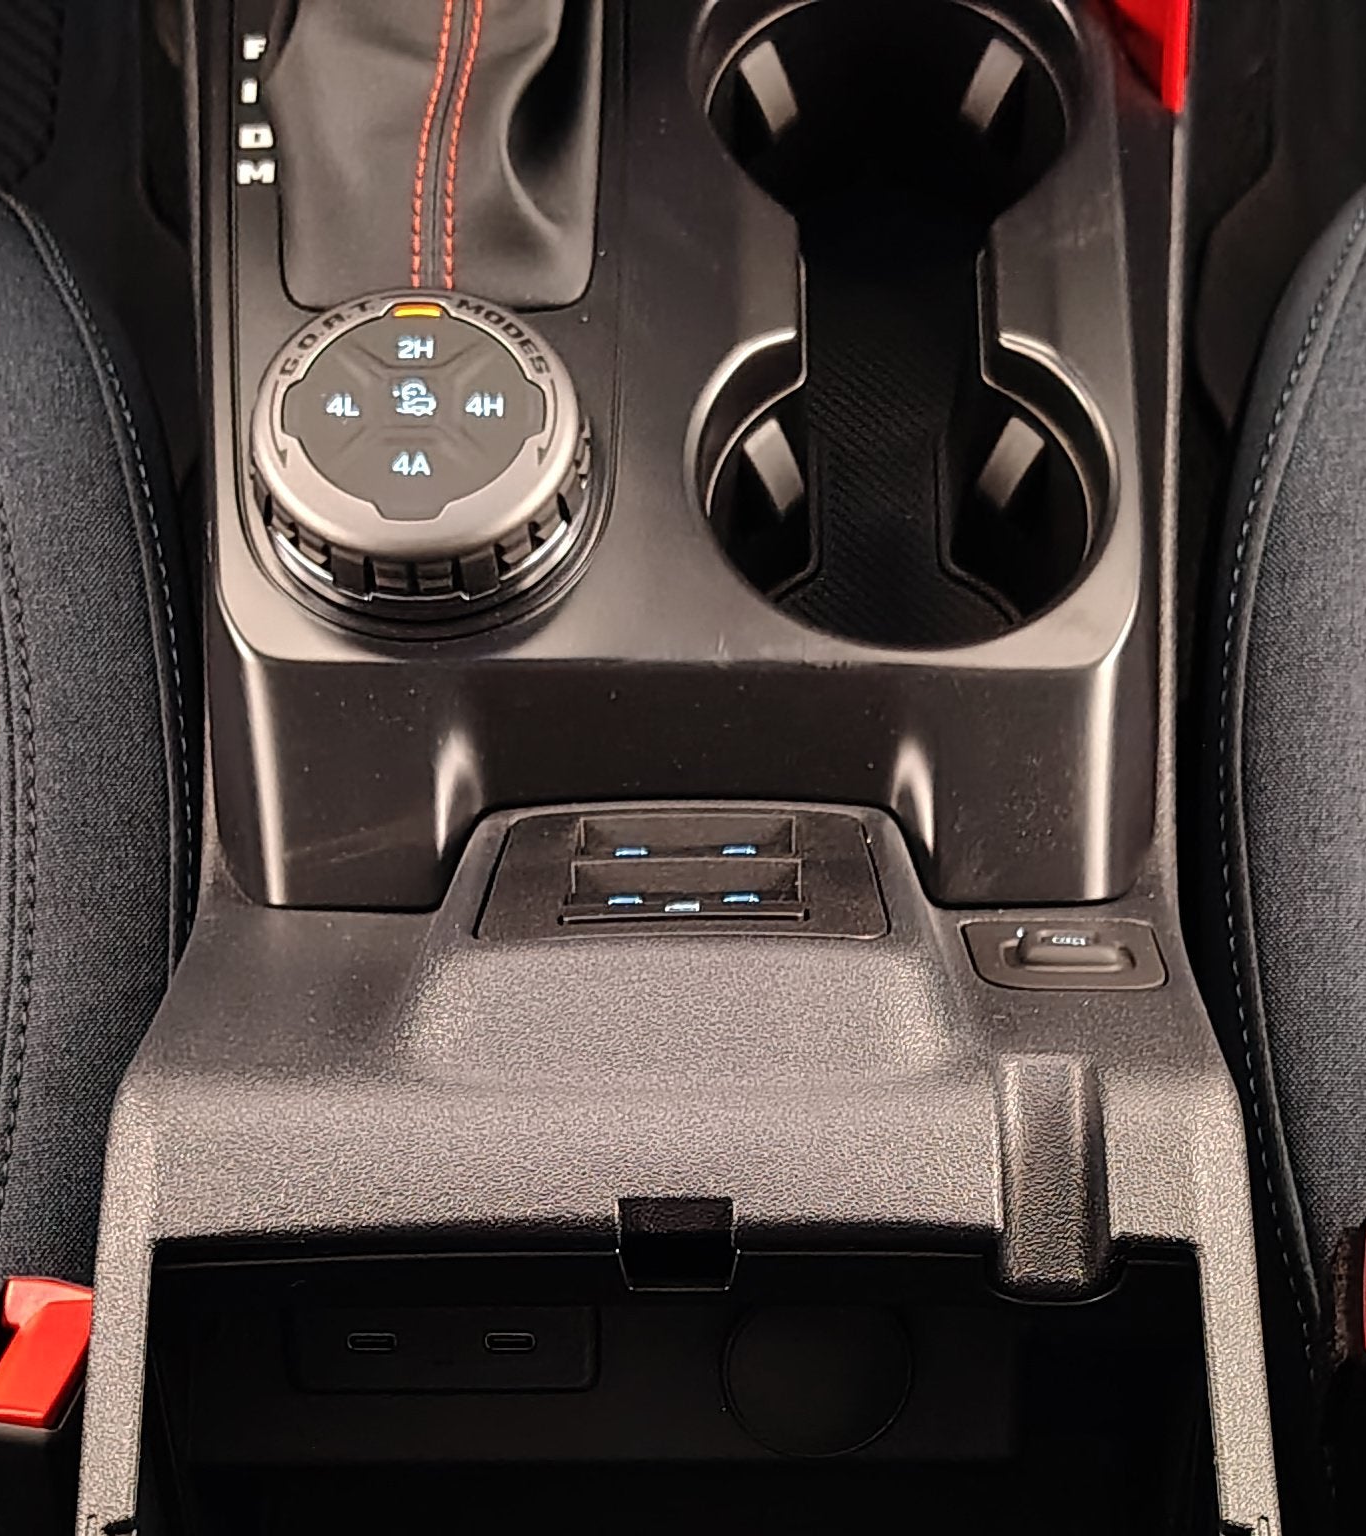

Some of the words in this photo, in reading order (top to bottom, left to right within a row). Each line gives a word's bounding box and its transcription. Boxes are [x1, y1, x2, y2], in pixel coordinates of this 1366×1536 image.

[238, 123, 273, 148] D
[236, 159, 276, 184] M
[397, 336, 434, 359] 2H
[456, 299, 550, 374] MODES
[325, 393, 360, 417] 4L
[465, 392, 504, 417] 4H
[392, 451, 431, 476] 4A
